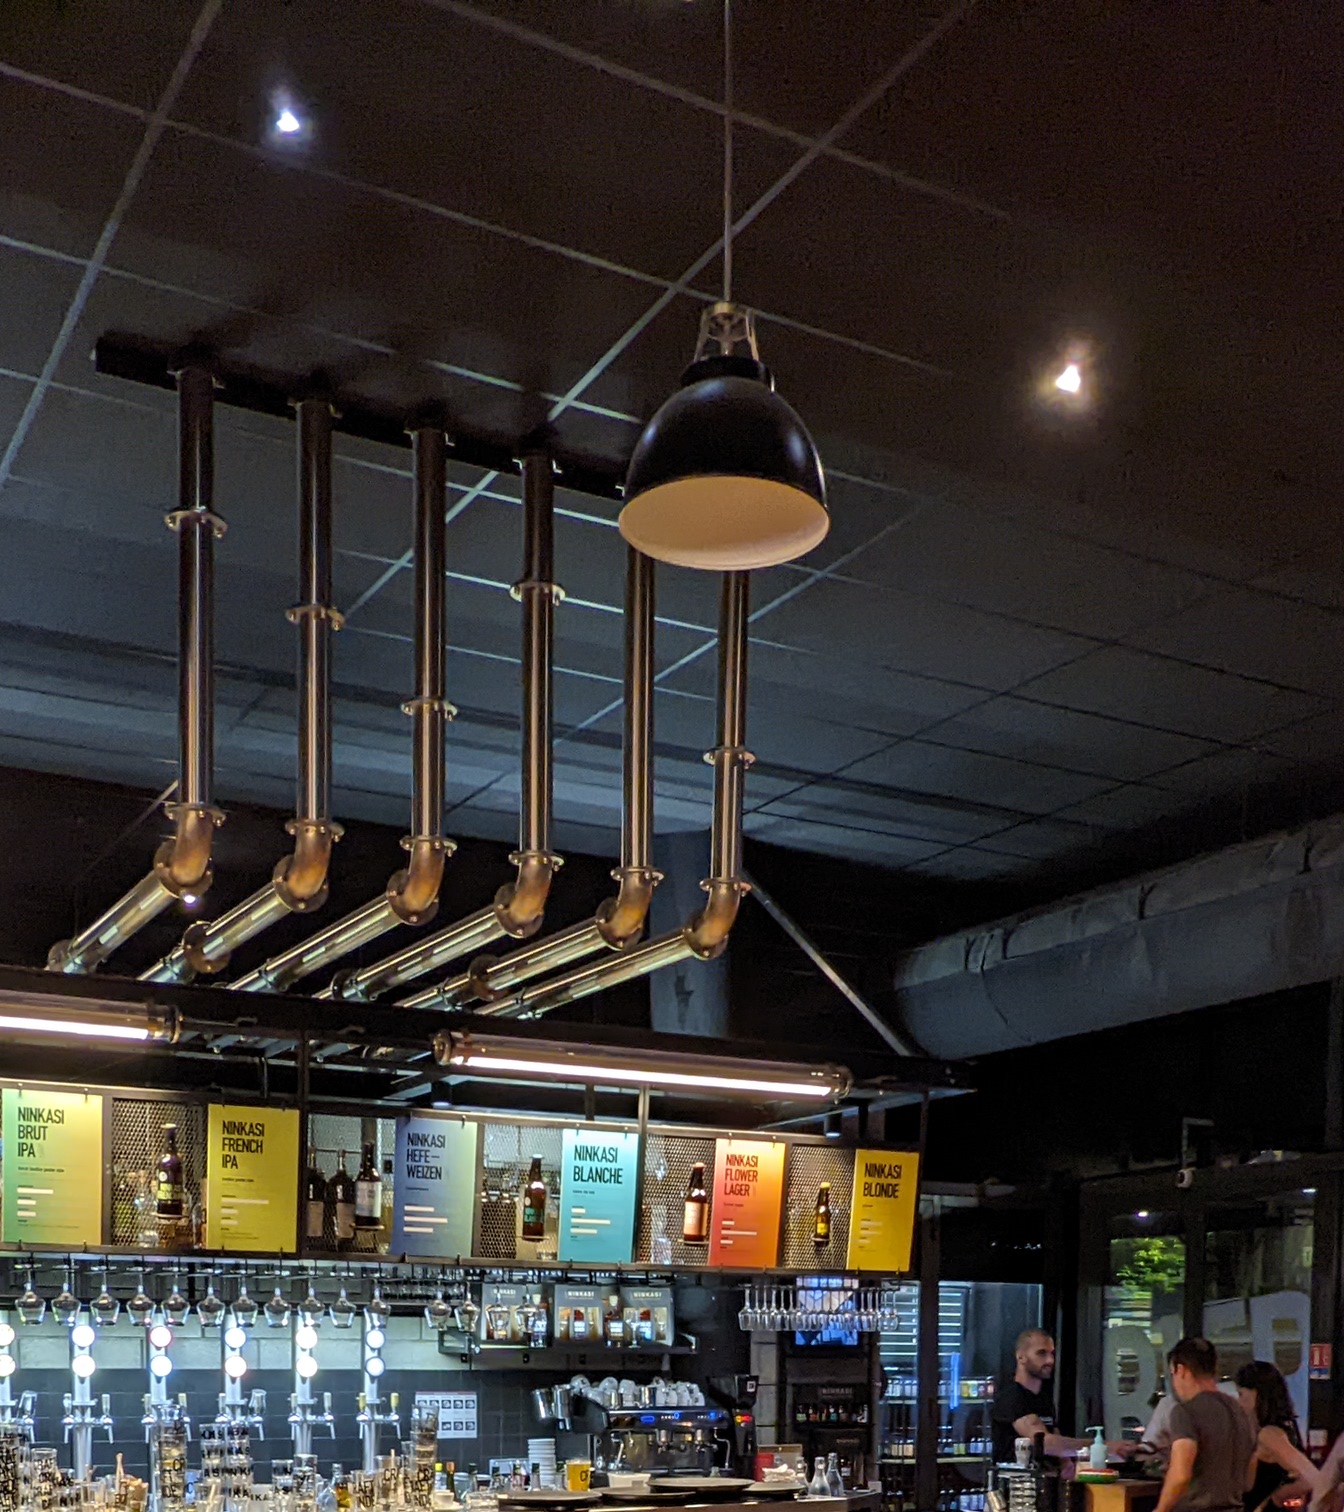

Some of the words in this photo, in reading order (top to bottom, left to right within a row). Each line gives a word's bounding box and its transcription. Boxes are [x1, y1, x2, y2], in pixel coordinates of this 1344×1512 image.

[17, 1106, 65, 1124] NINKASI
[17, 1125, 48, 1141] BRUT
[222, 1120, 265, 1137] NINKASI
[222, 1137, 263, 1154] FRENCH
[407, 1132, 446, 1148] NINKASI
[17, 1142, 36, 1158] IPA
[574, 1144, 618, 1163] NINKASI
[222, 1154, 238, 1169] IPA
[725, 1154, 758, 1168] NINKASI
[406, 1164, 442, 1180] WEIZEN
[573, 1165, 623, 1184] BLANCHE
[725, 1168, 758, 1182] FLOWER
[864, 1162, 902, 1179] NINKASI
[724, 1183, 750, 1197] LAGER
[863, 1182, 900, 1199] BLONDE
